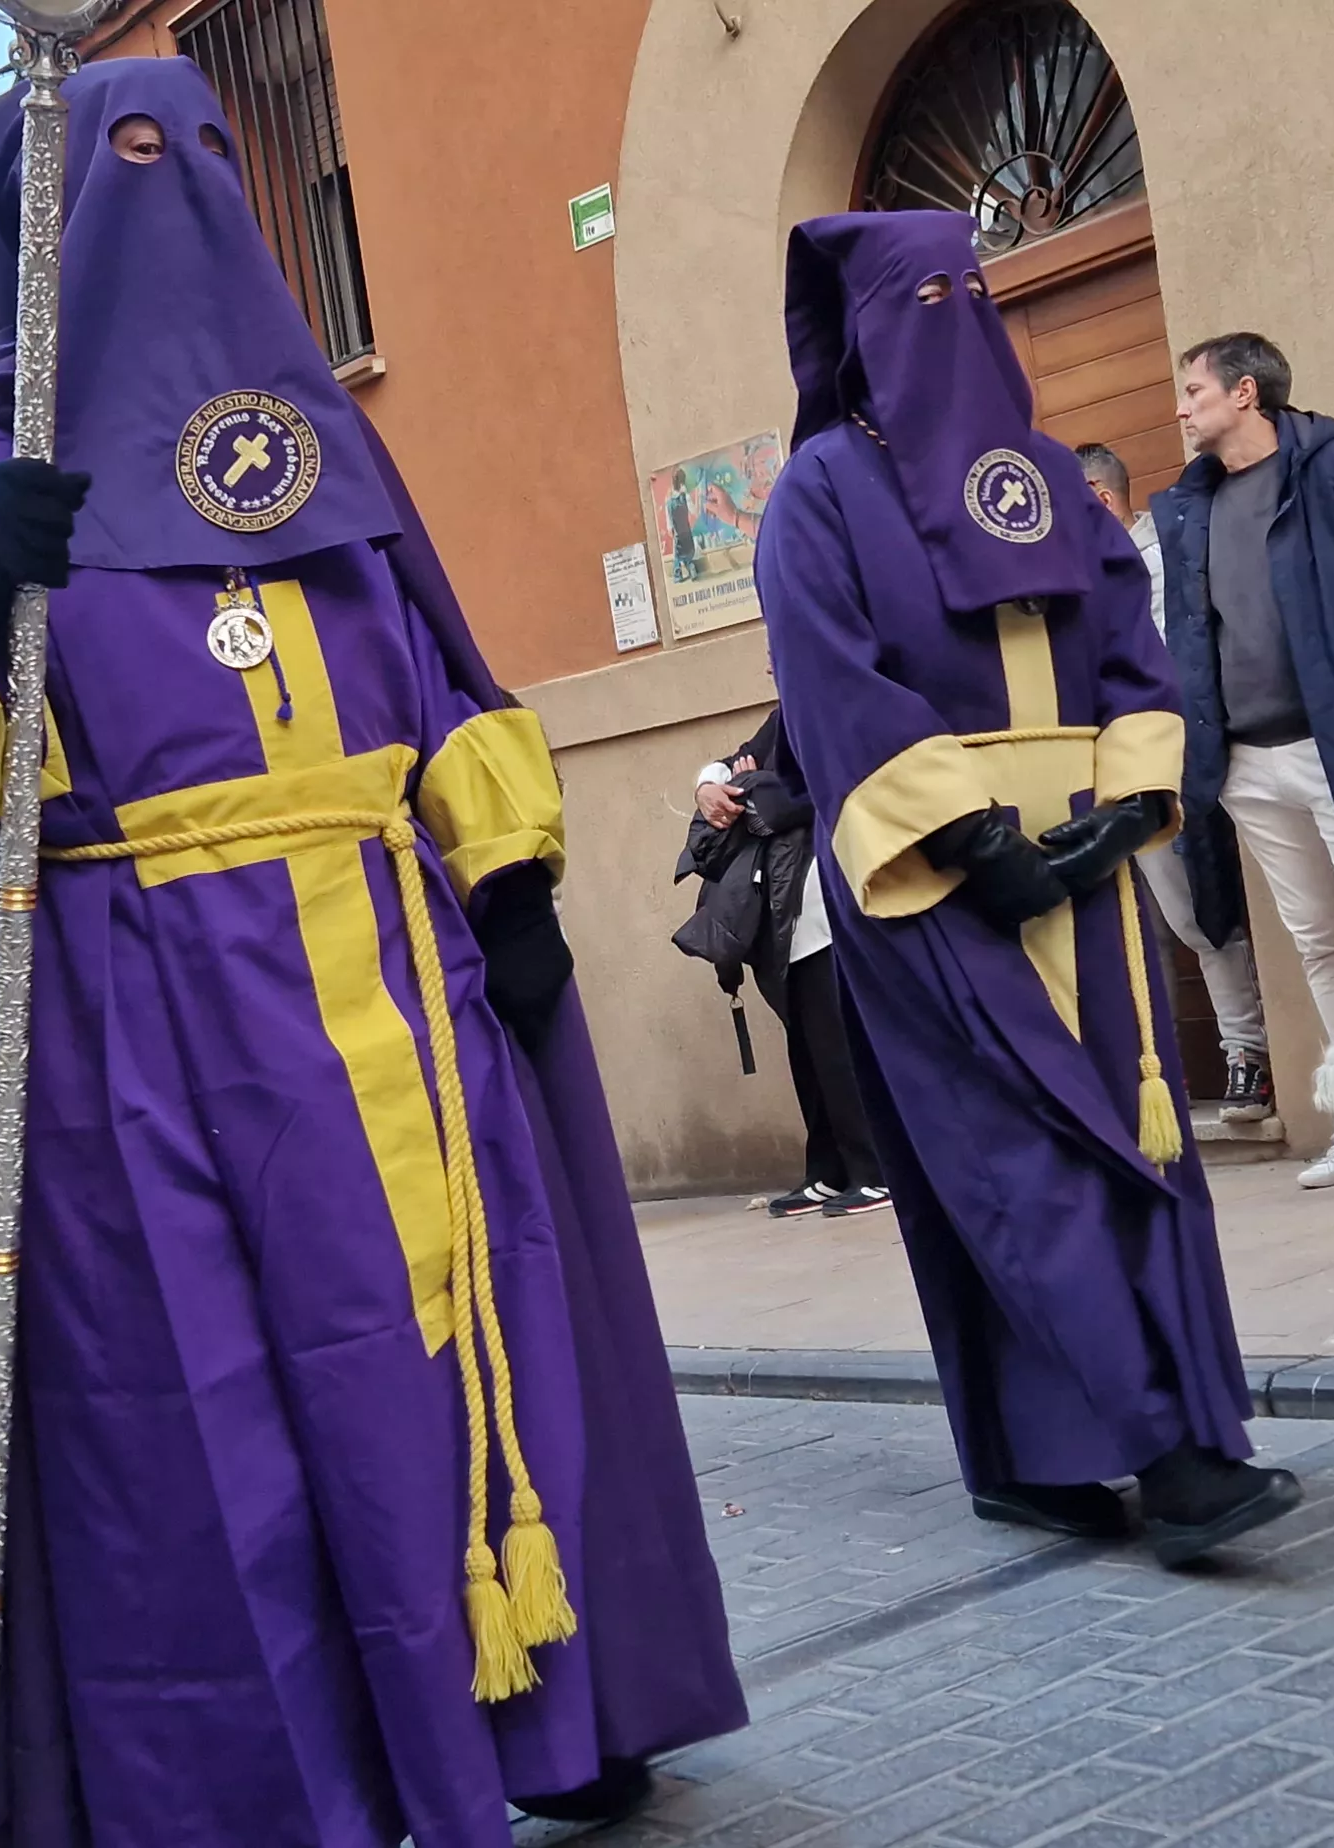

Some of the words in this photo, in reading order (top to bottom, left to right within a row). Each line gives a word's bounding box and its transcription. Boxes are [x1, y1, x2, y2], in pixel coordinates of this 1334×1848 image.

[204, 394, 258, 421] NUESTRO
[259, 395, 298, 424] PADRE
[192, 416, 206, 435] DE
[257, 412, 284, 435] Rex
[195, 497, 226, 523] REAL
[227, 513, 275, 529] HUESCA
